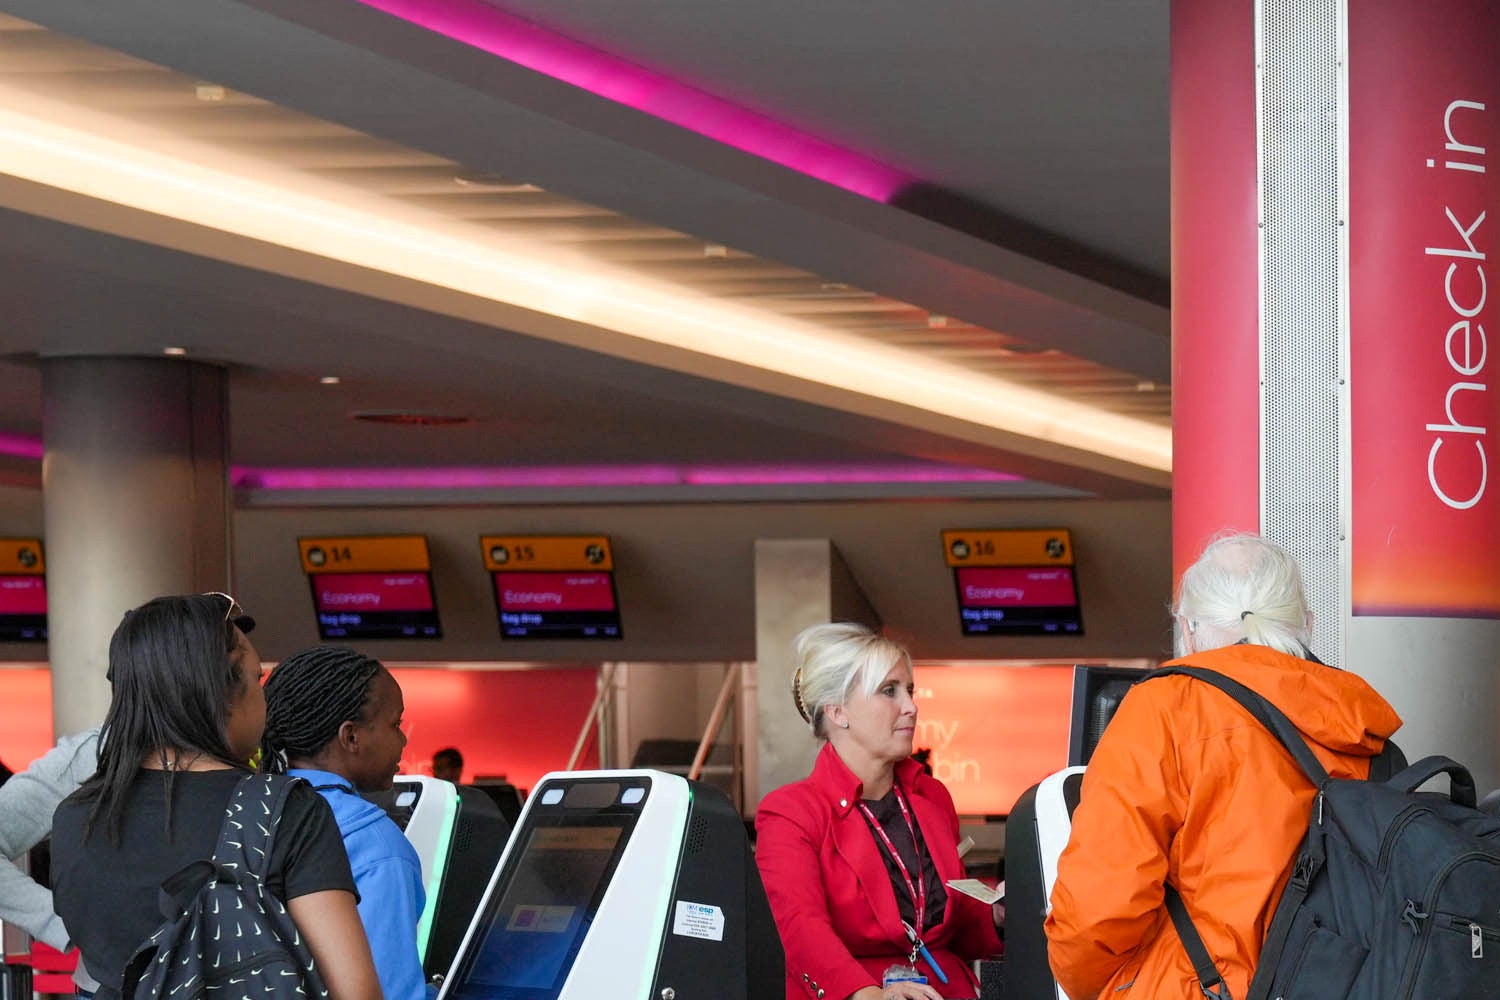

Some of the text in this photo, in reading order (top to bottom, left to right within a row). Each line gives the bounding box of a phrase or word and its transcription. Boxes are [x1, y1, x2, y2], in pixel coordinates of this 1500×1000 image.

[1425, 98, 1488, 510] Check in
[331, 546, 352, 562] 14
[514, 545, 535, 560] 15
[974, 540, 996, 556] 16
[322, 590, 380, 605] Economy
[504, 589, 562, 605] Economy
[965, 585, 1024, 600] Economy
